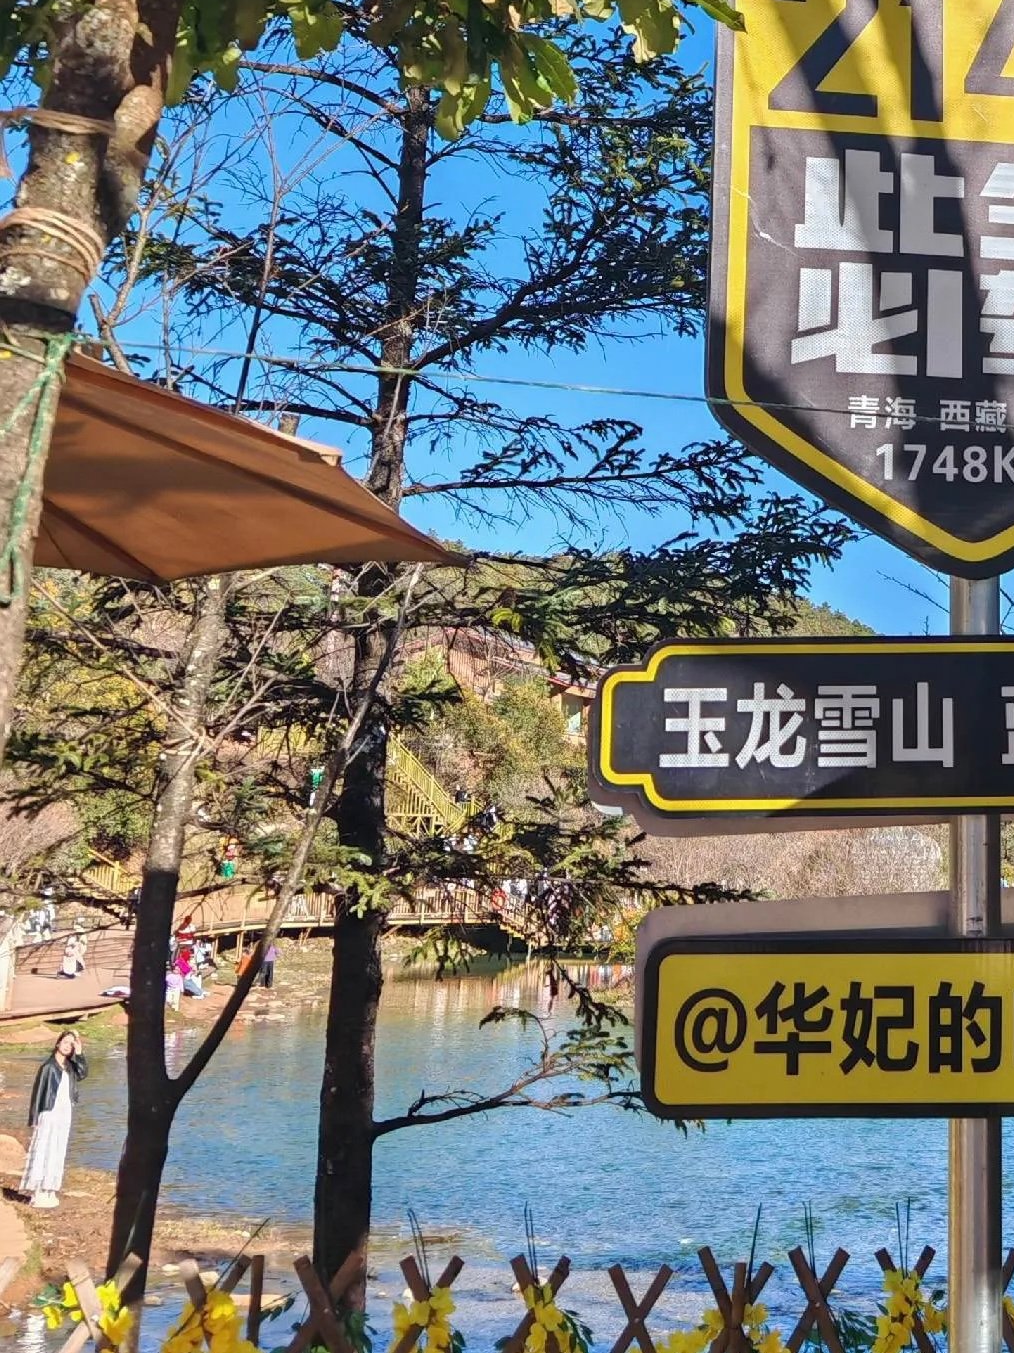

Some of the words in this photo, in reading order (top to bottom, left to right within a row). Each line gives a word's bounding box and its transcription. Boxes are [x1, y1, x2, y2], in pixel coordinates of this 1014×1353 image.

[847, 394, 917, 431] 青海
[938, 398, 1008, 434] 西藏
[657, 680, 955, 770] 玉龙雪山
